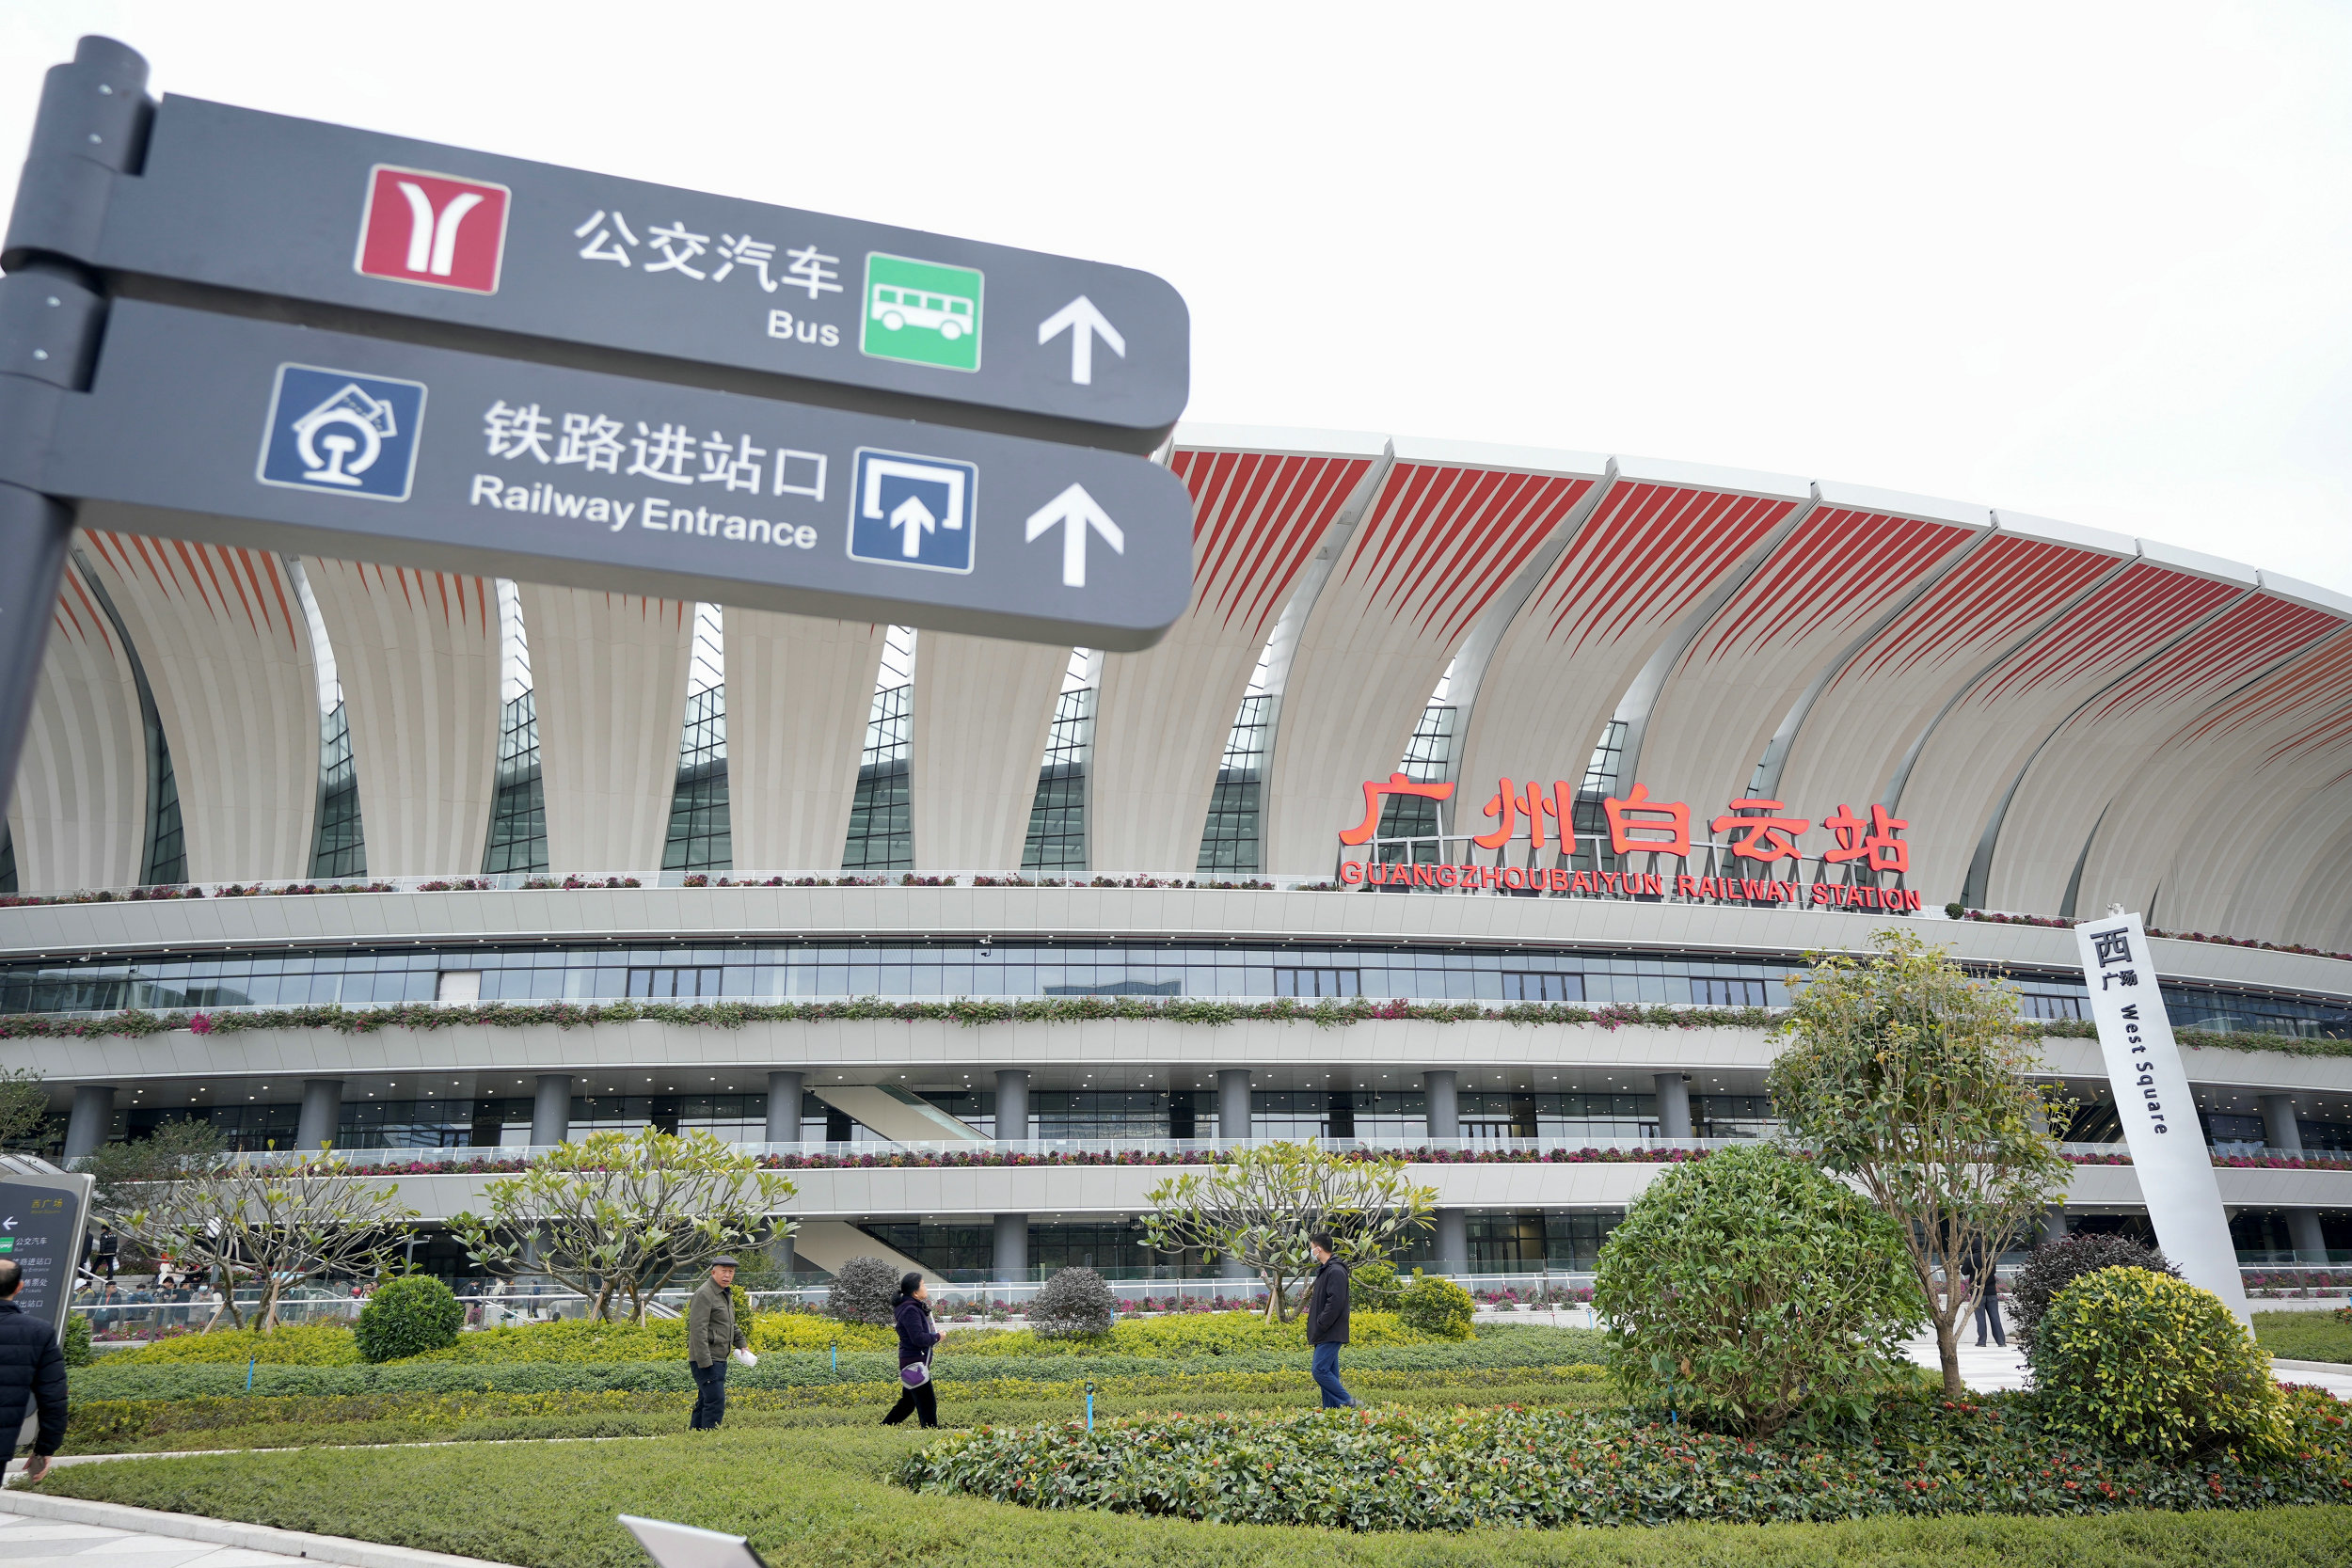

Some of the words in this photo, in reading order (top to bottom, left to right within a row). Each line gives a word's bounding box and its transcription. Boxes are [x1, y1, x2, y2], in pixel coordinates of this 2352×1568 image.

[574, 209, 844, 300] 公交汽车
[766, 309, 840, 347] Bus
[483, 400, 829, 503] 铁路进站口
[470, 473, 635, 533] Railway
[642, 497, 818, 549] Entrance
[1338, 772, 1910, 873] 广州白云站
[1677, 874, 1799, 904] RAILWAY
[1811, 882, 1922, 911] STATION
[2121, 1003, 2146, 1053] West
[2136, 1061, 2168, 1134] Square
[15, 1237, 48, 1245] 公交汽车
[31, 1197, 63, 1209] 西广场
